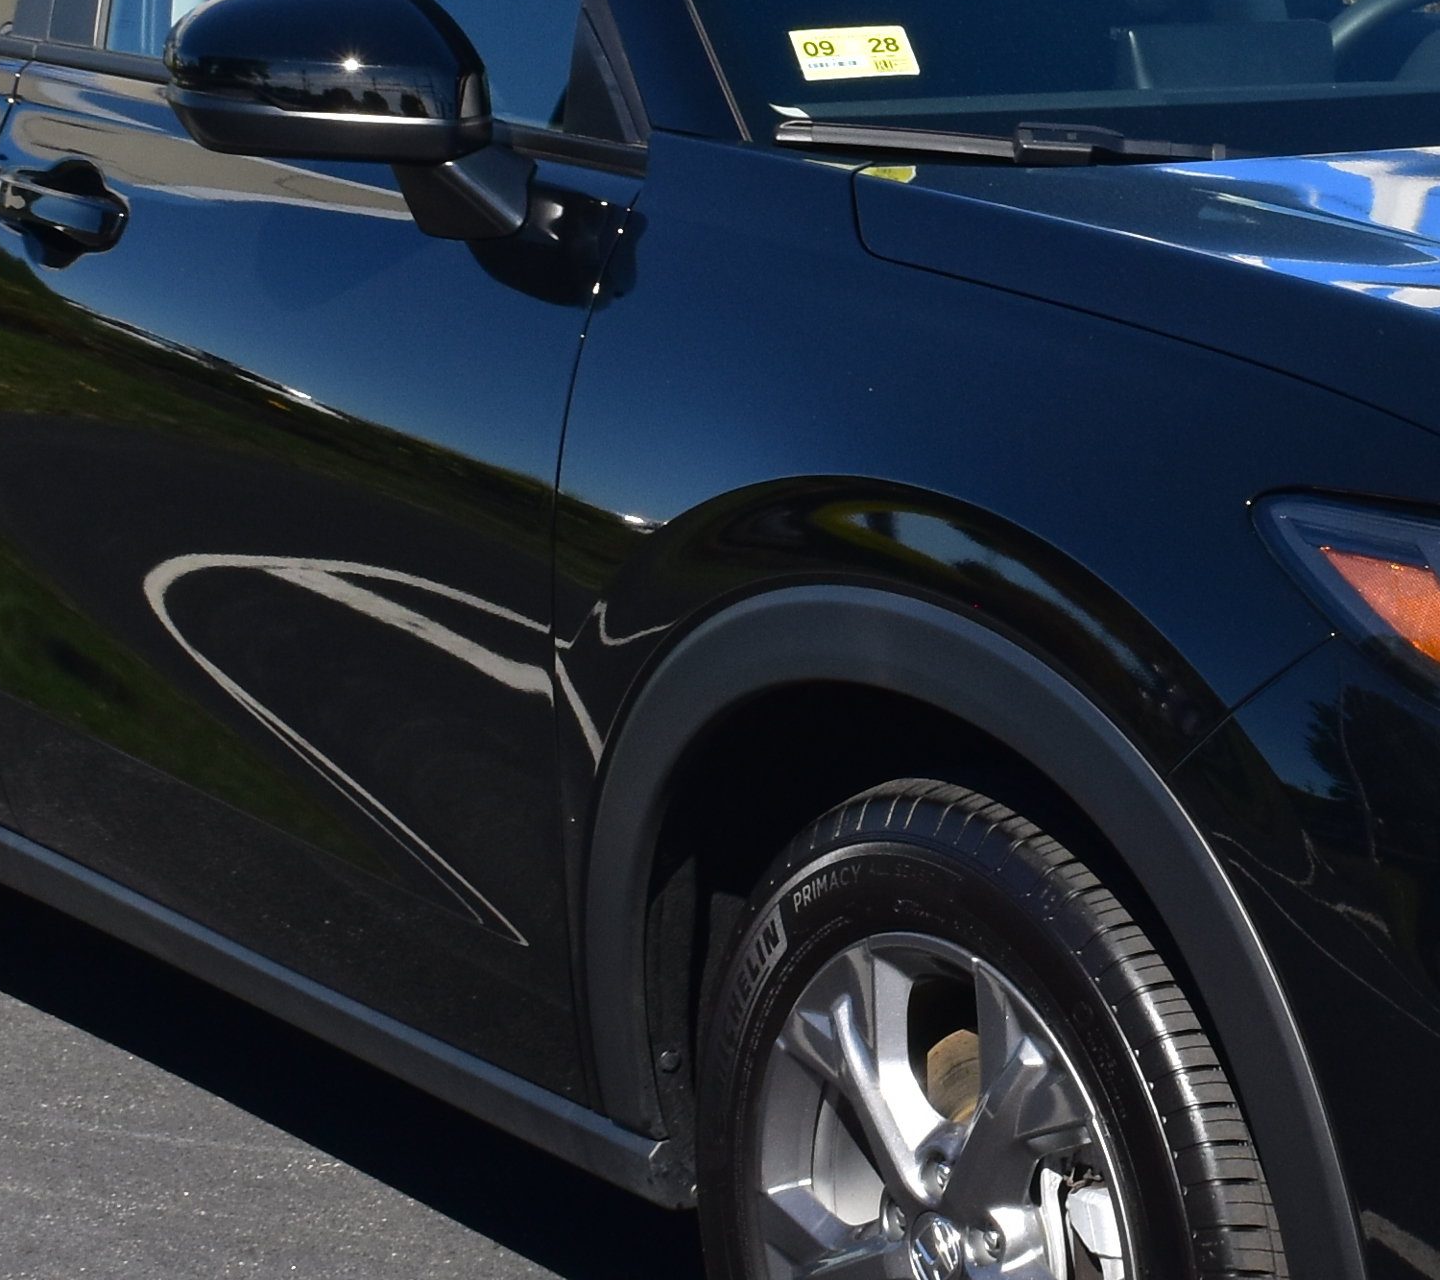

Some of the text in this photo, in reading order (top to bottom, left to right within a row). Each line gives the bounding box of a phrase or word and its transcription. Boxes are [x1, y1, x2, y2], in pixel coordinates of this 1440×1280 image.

[803, 37, 900, 57] 09 28
[792, 864, 862, 913] PRIMACY
